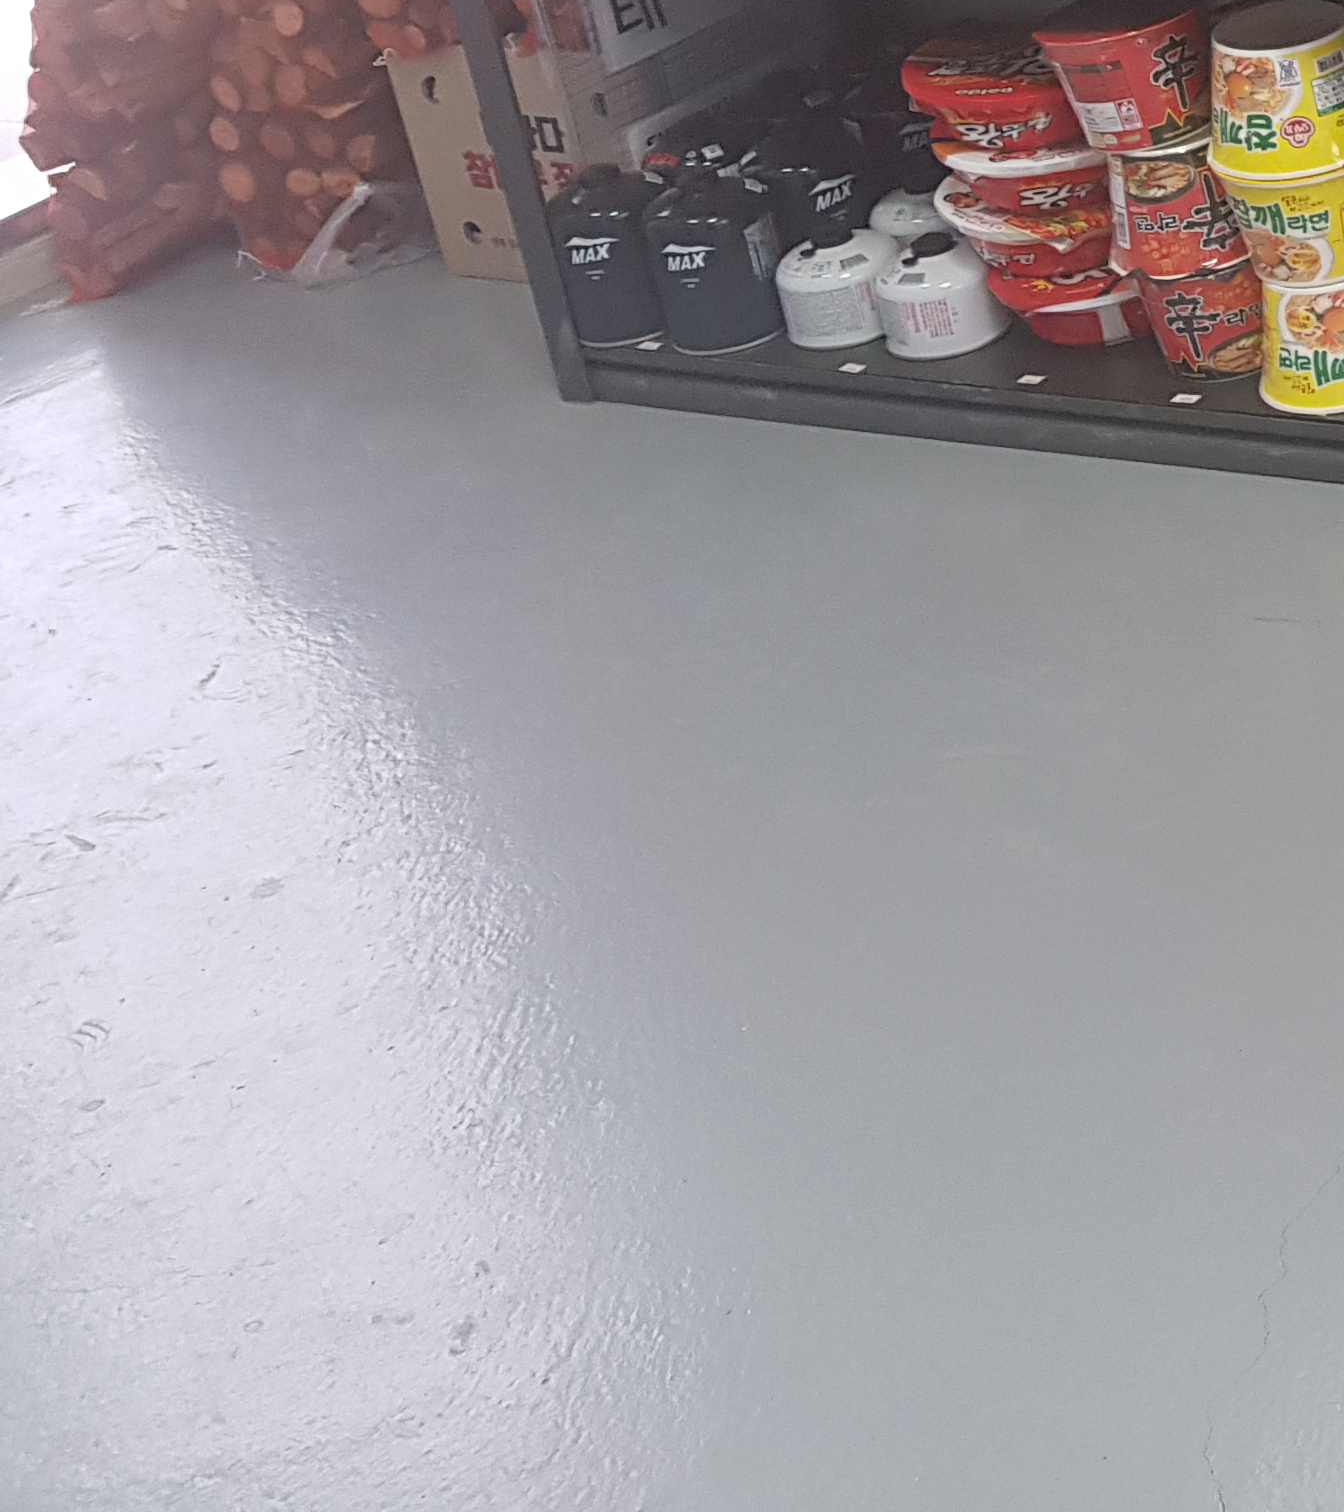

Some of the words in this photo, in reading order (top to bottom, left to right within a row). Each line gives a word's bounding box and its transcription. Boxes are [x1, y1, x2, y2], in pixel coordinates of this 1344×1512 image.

[815, 182, 852, 212] MAX
[572, 245, 610, 265] MAX
[668, 251, 706, 272] MAX
